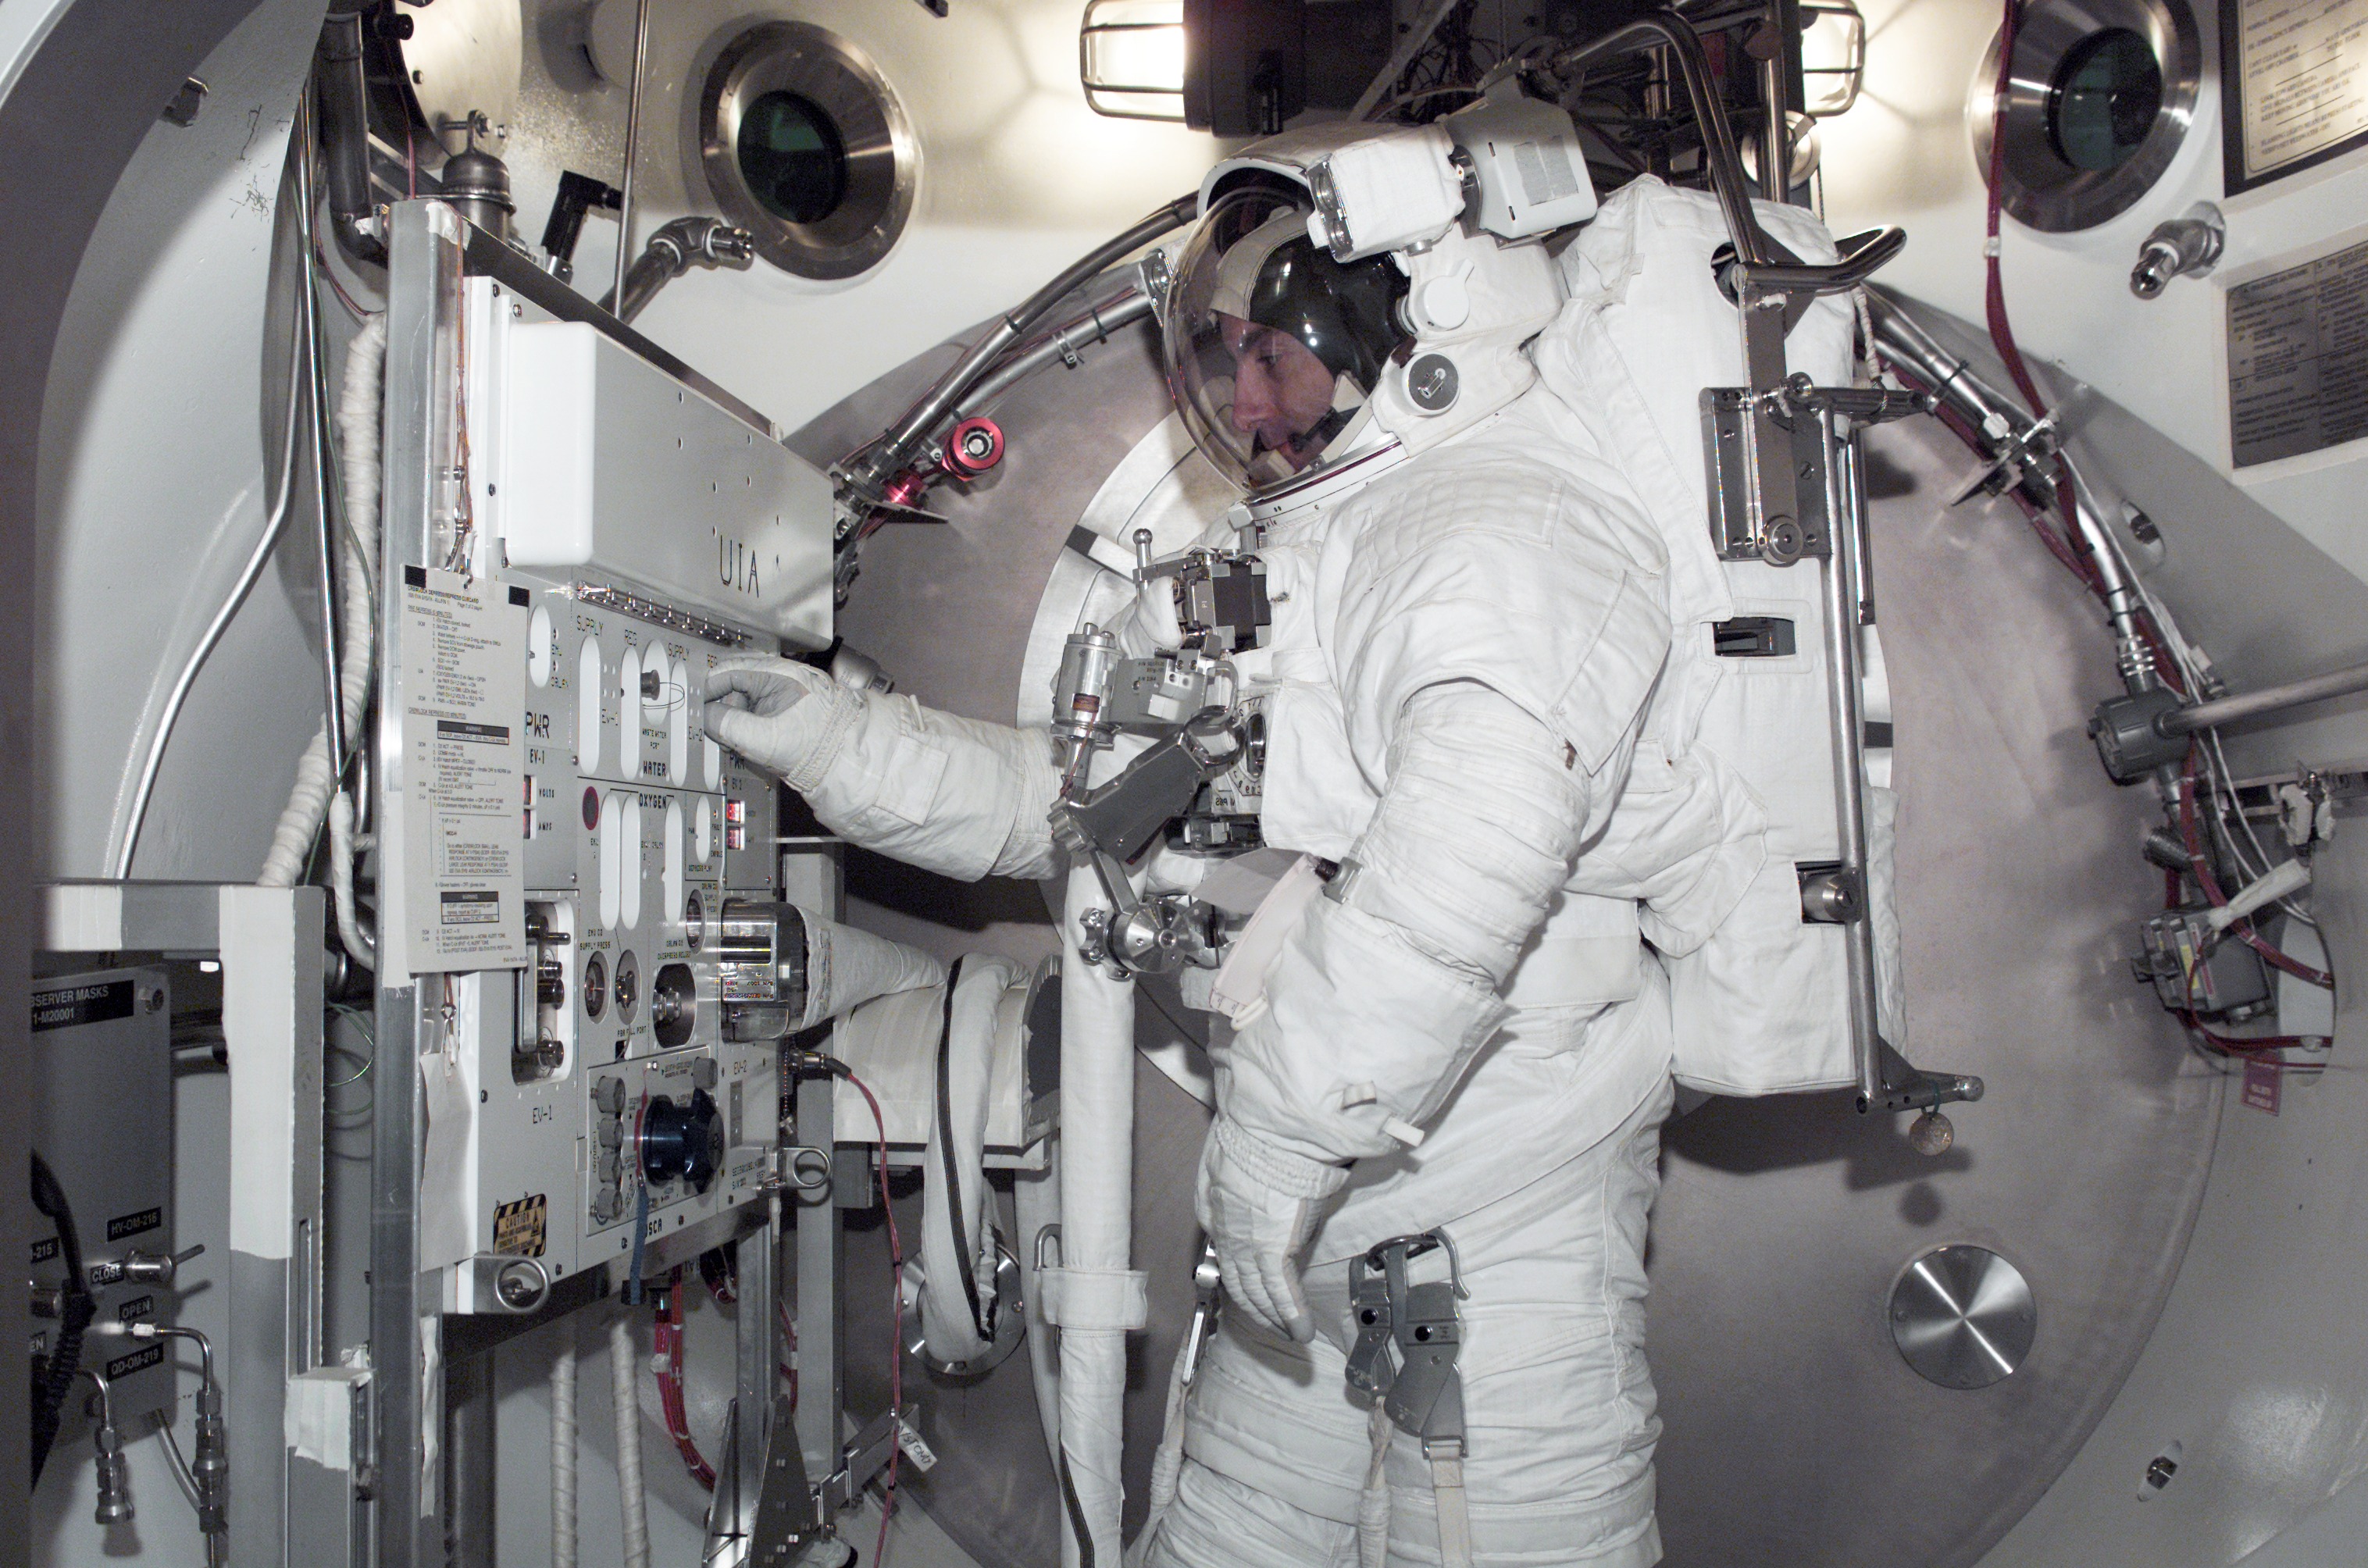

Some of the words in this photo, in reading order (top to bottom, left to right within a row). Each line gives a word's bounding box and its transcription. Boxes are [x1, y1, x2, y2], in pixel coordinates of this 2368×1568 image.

[720, 535, 759, 598] UIA
[526, 711, 550, 739] PWR
[530, 748, 544, 764] EV-1
[643, 760, 666, 777] WATER
[539, 788, 555, 799] VOLTS
[639, 793, 667, 809] OXYGEN
[538, 822, 552, 831] AMPS
[580, 942, 596, 950] SUPPLY
[76, 985, 109, 1000] MASKS
[733, 1060, 747, 1075] EV-2
[533, 1104, 552, 1124] EV-1
[506, 1210, 530, 1229] CAUTION
[92, 1267, 121, 1283] CLOSE
[122, 1300, 150, 1319] OPEN
